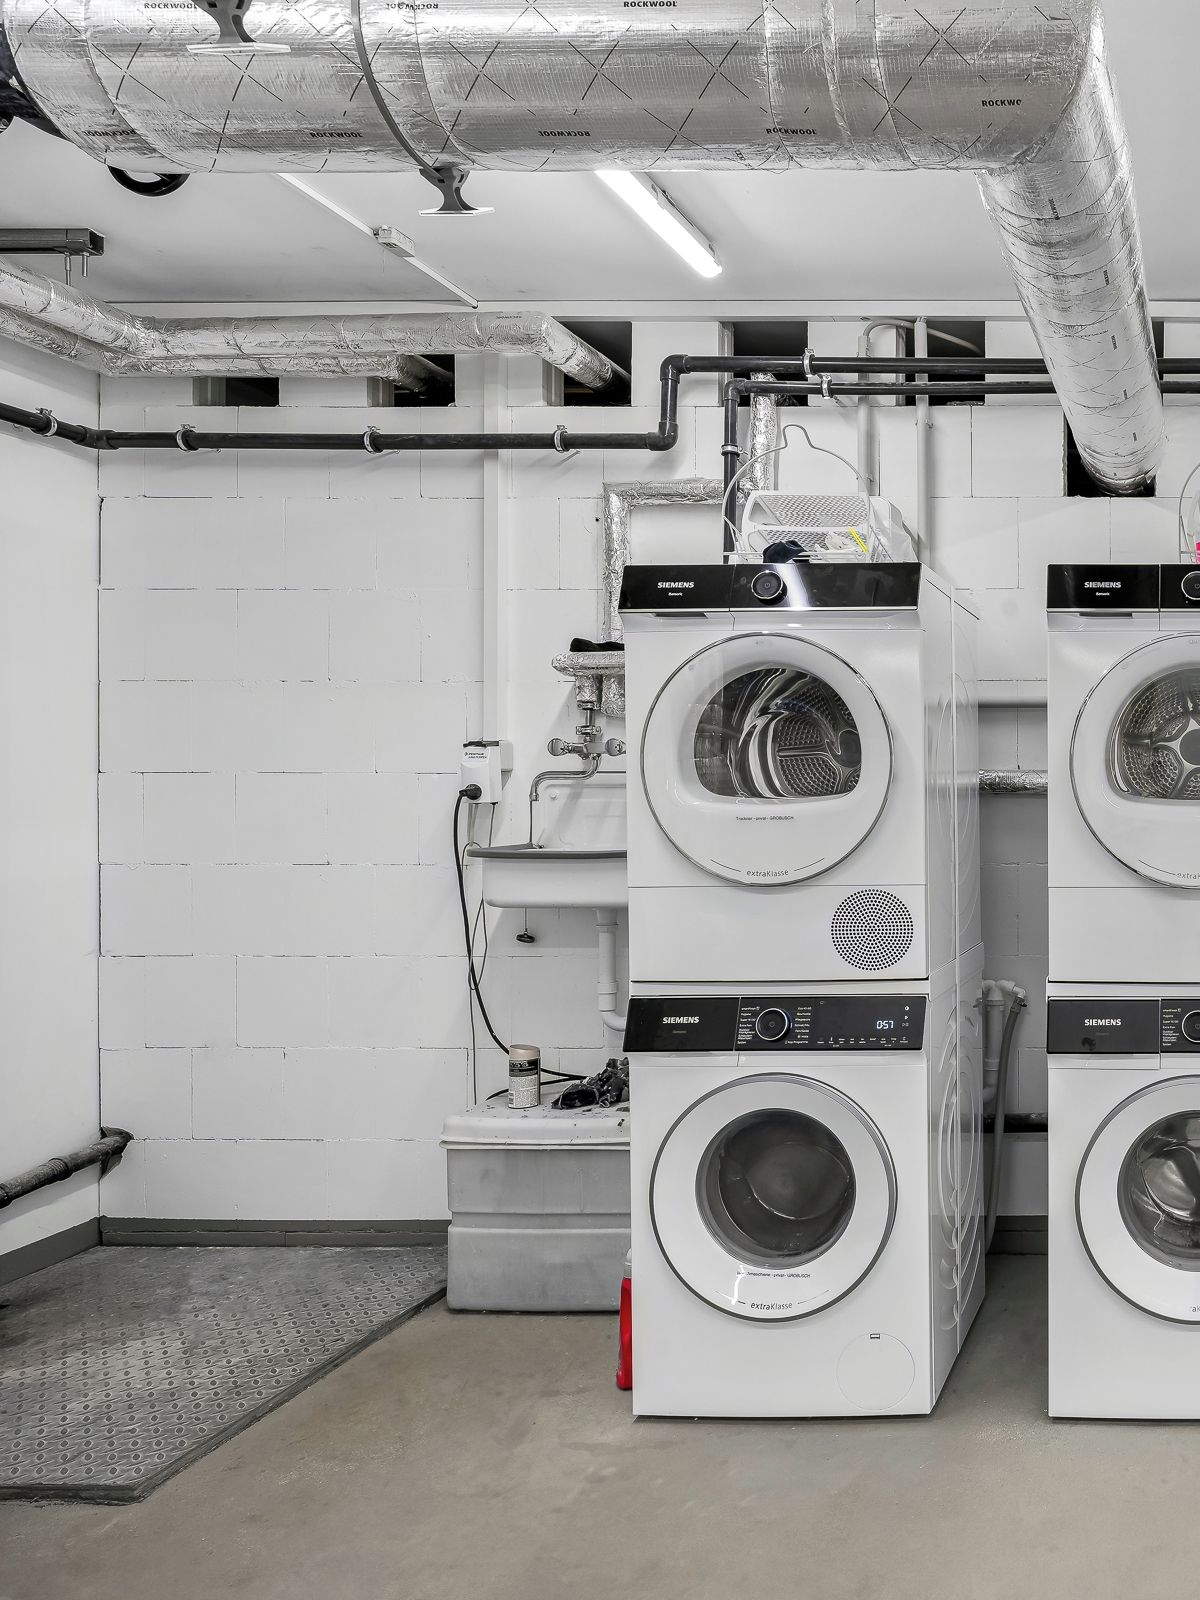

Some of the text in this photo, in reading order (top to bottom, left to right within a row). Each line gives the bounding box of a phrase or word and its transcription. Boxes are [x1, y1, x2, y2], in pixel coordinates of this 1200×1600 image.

[144, 2, 198, 10] ROCKWOOL
[766, 127, 817, 135] ROCKWOOL
[657, 581, 695, 589] SIEMENS
[1083, 581, 1122, 589] SIEMENS
[746, 869, 789, 877] extraKlasse
[662, 1016, 700, 1024] SIEMENS
[1084, 1018, 1122, 1026] SIEMENS
[750, 1302, 793, 1310] extraKlasse
